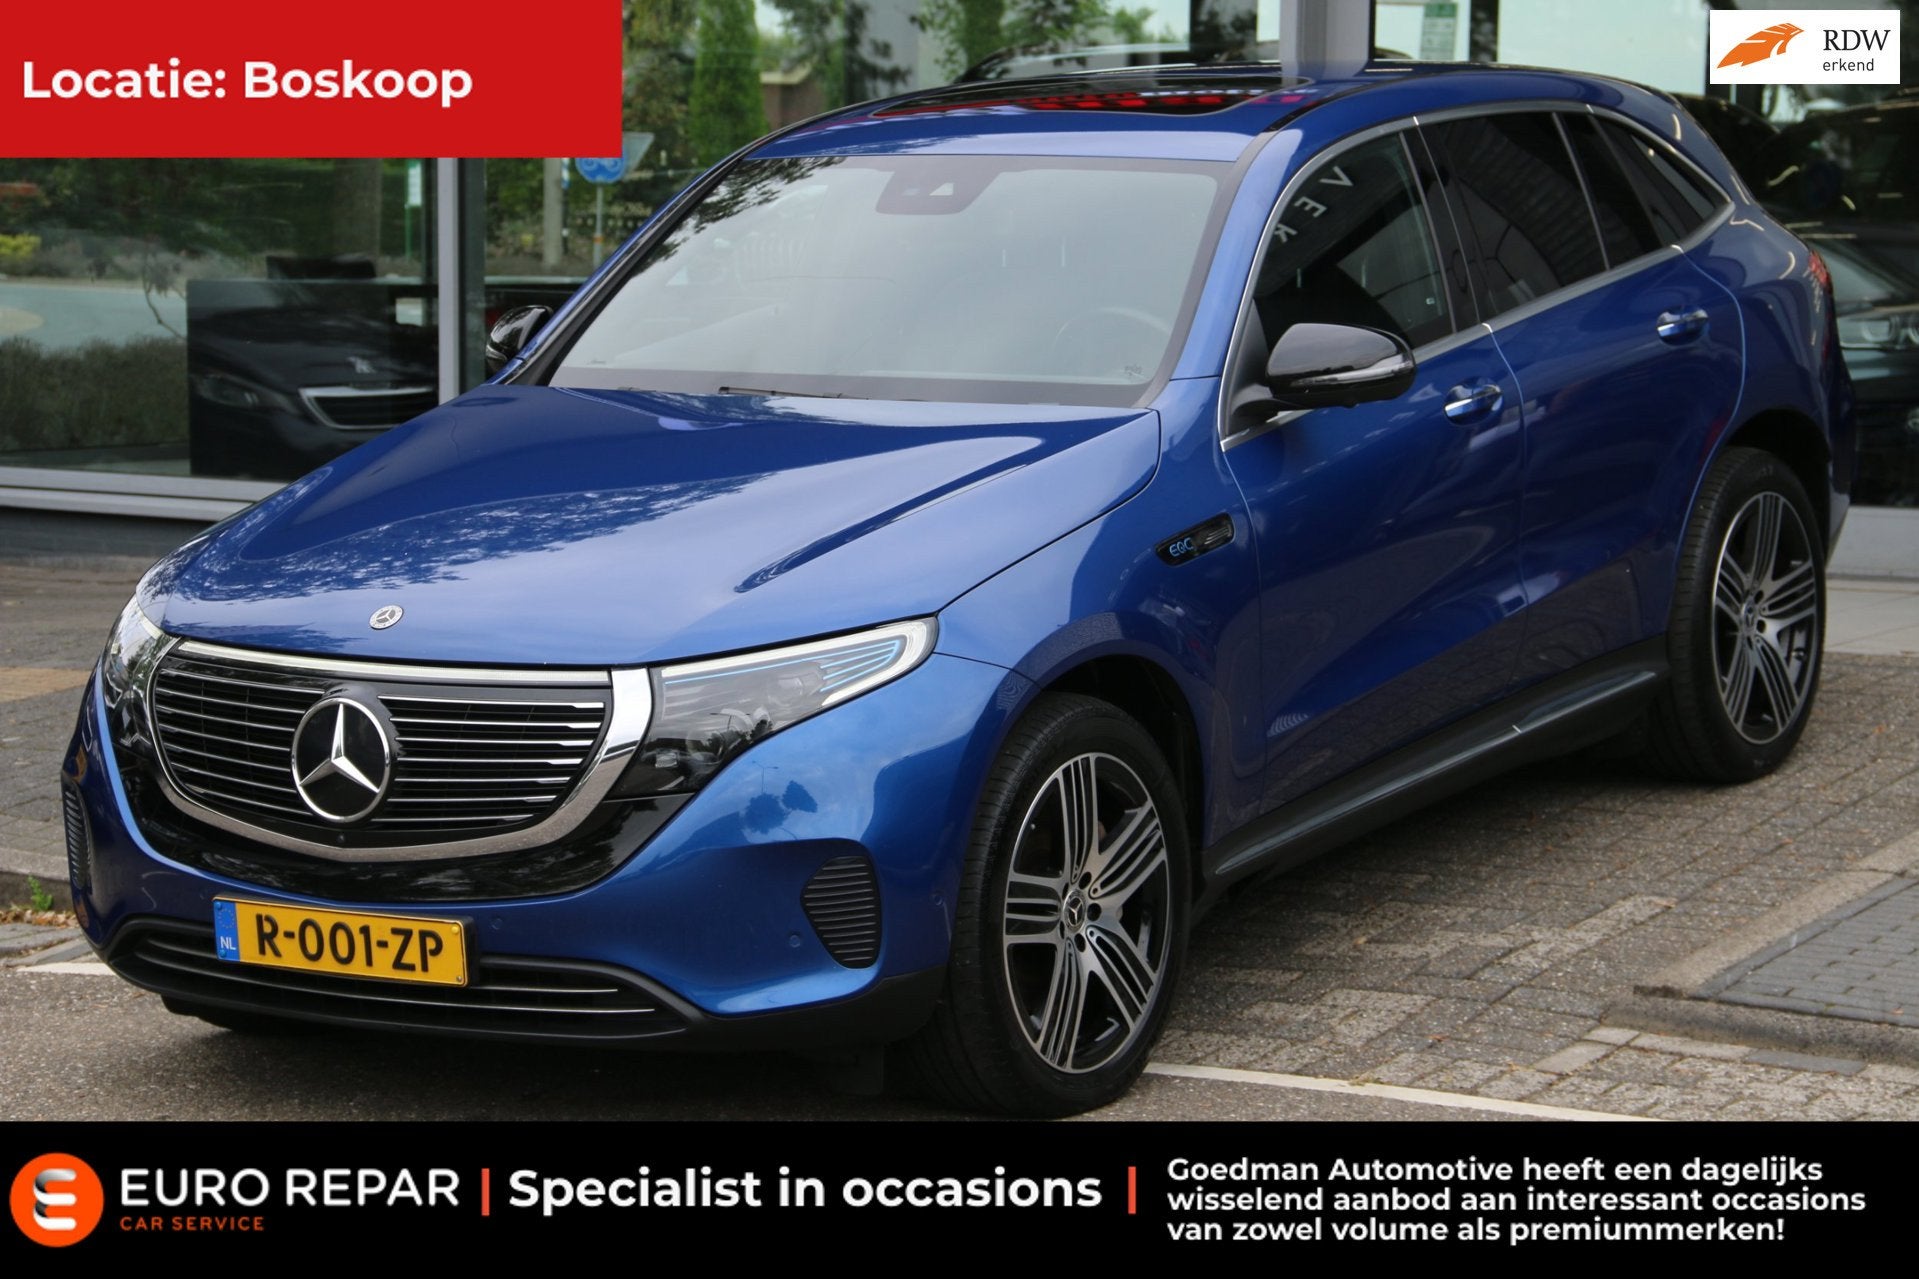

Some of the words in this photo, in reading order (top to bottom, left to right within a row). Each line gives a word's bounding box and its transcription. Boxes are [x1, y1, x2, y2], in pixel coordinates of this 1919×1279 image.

[1169, 537, 1194, 557] EQC
[220, 936, 236, 950] NL
[256, 914, 443, 973] R-001-ZP
